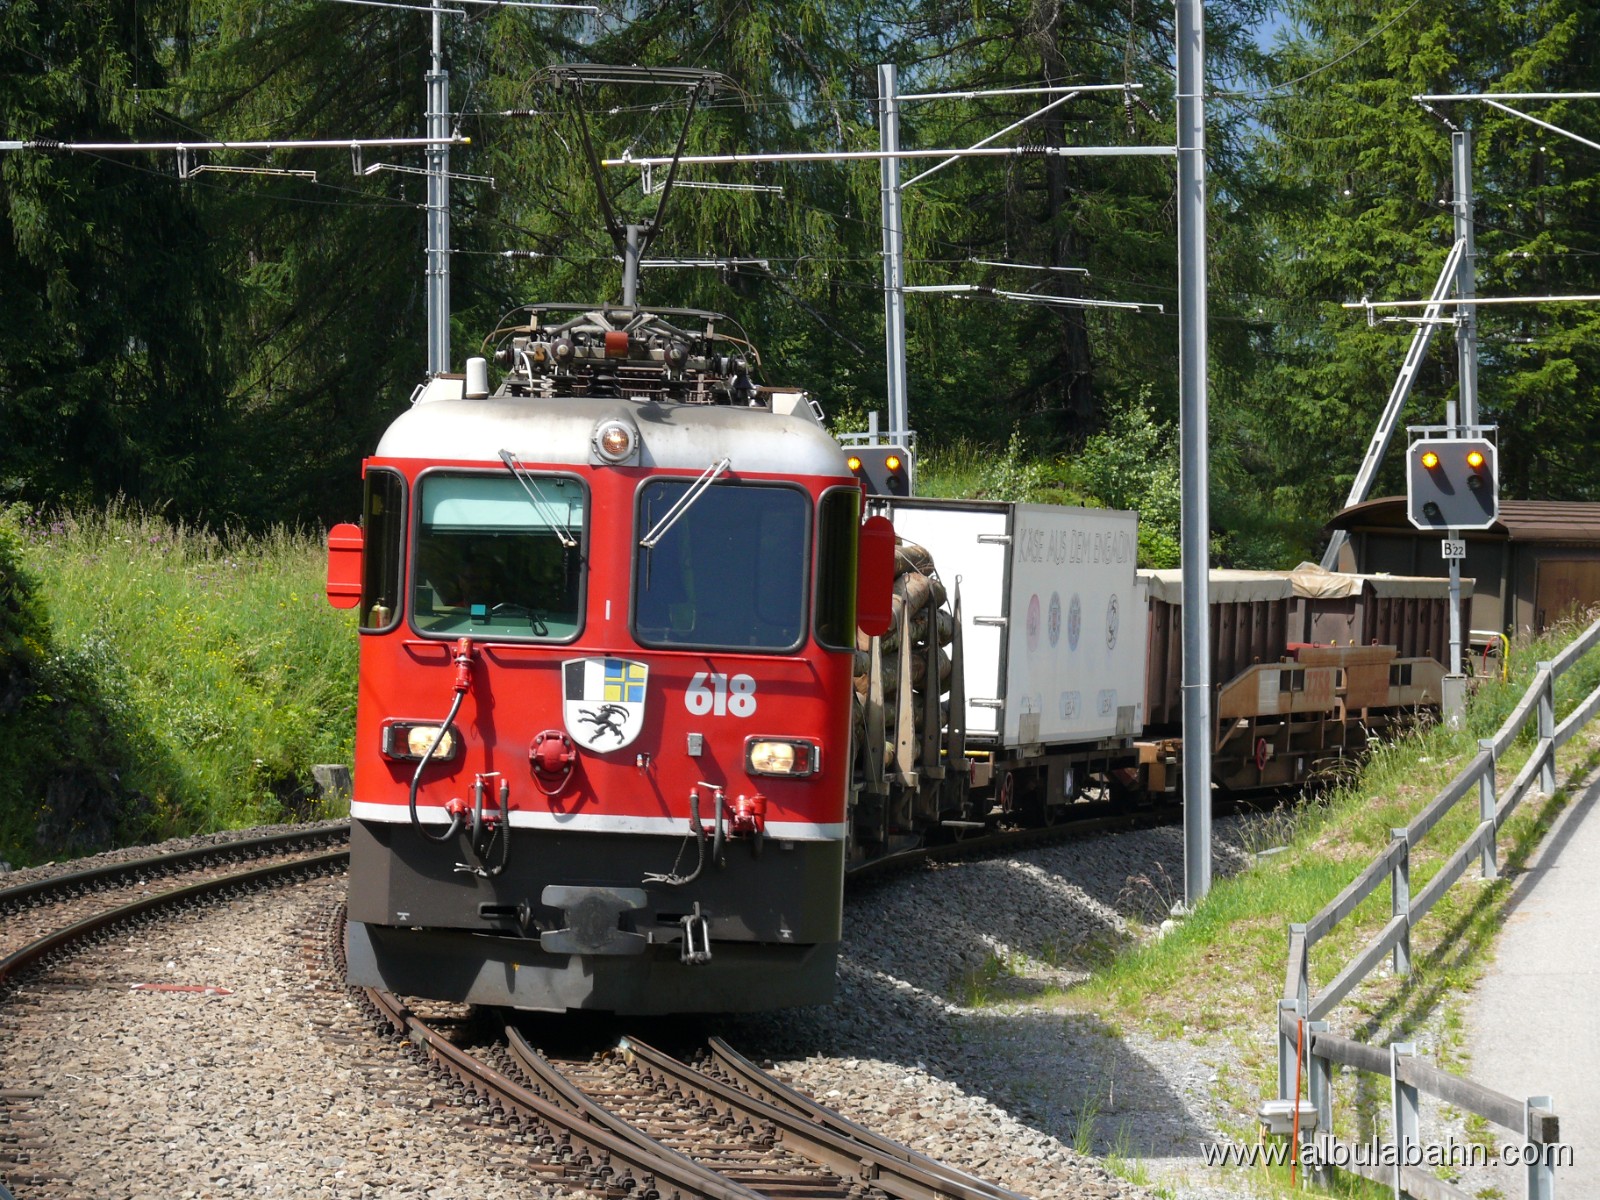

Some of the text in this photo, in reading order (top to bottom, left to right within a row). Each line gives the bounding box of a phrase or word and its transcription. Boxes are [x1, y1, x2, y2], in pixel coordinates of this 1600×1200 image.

[1046, 529, 1067, 566] AUS
[1069, 529, 1092, 565] DEM
[1093, 531, 1136, 565] ENGADIN
[684, 671, 758, 718] 618
